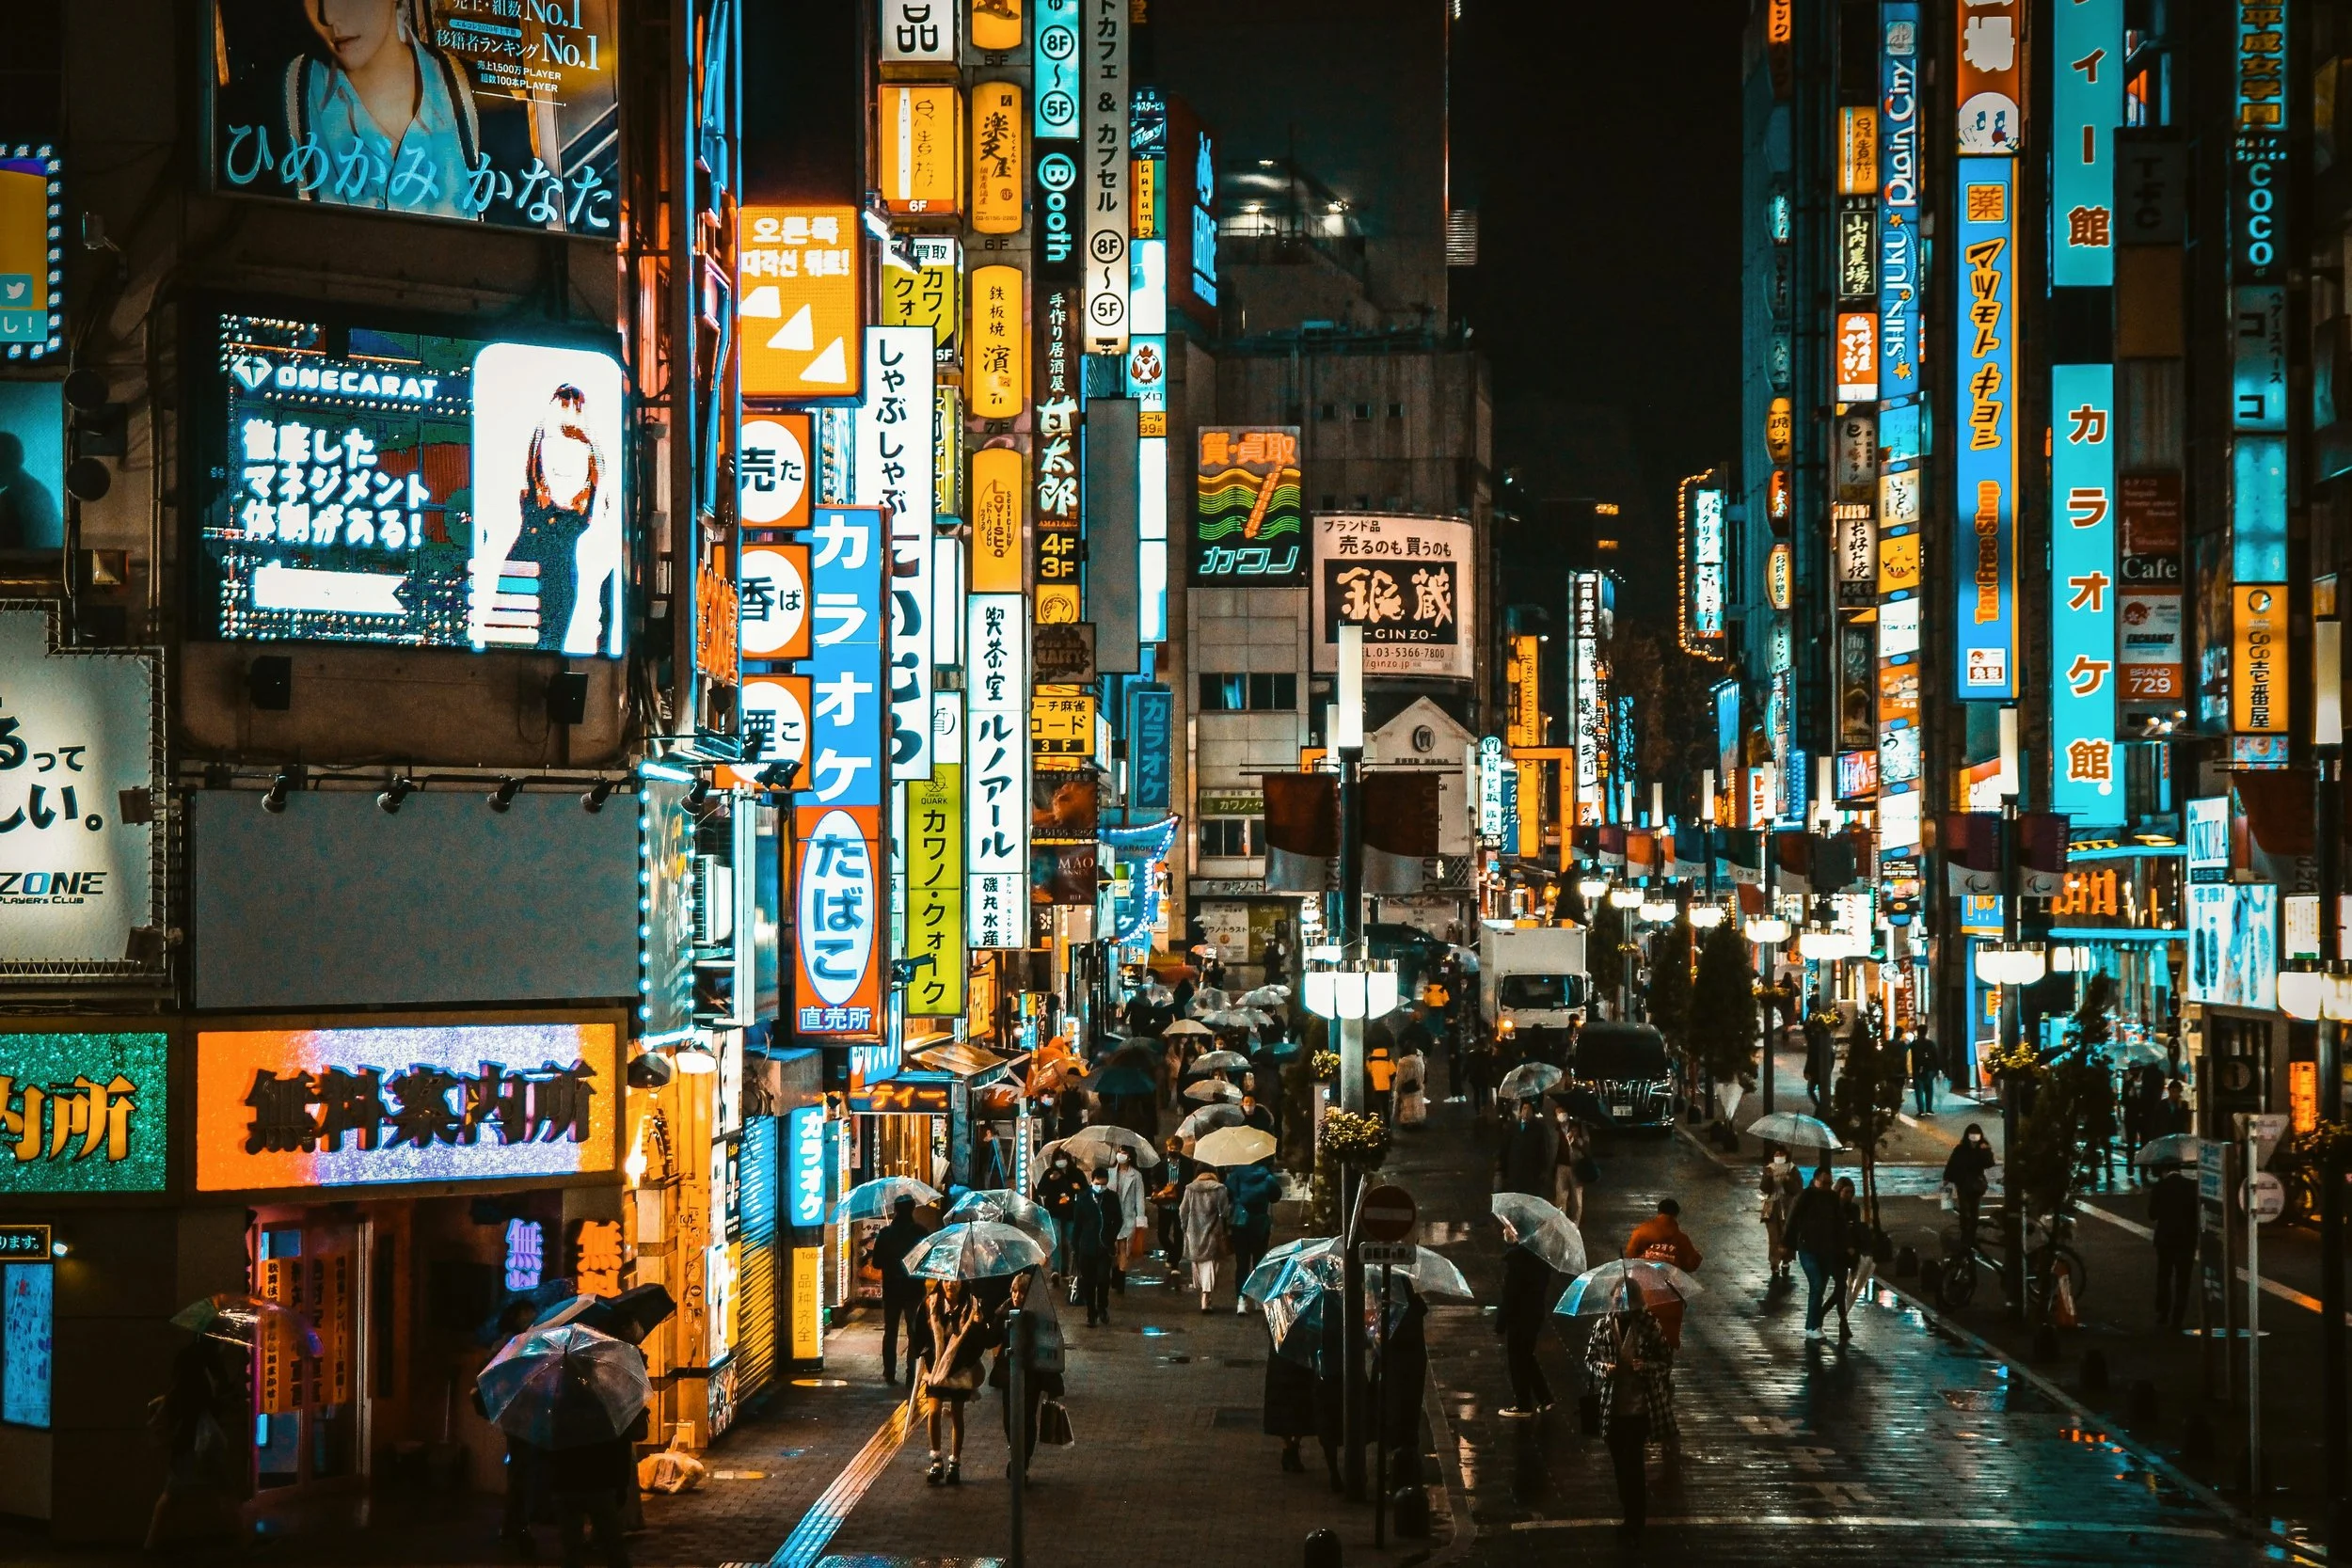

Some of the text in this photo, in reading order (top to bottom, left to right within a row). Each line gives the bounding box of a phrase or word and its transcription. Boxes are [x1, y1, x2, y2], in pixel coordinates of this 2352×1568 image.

[437, 29, 599, 71] 移籍者ランキング No.1
[1046, 35, 1069, 51] 8F
[520, 80, 558, 93] PLAYER
[524, 68, 562, 81] PLAYER
[1046, 101, 1069, 117] 5F
[1098, 92, 1118, 113] &
[2067, 0, 2111, 247] イー館
[227, 123, 612, 229] ひめがみ かなた
[1097, 123, 1119, 213] カプセル
[908, 200, 927, 213] 6F
[2248, 162, 2274, 266] COCO
[1097, 239, 1118, 255] 8F
[988, 286, 1006, 338] 鉄板焼
[1097, 302, 1118, 317] 5F
[1884, 230, 1915, 357] SHINJUKU
[1049, 293, 1067, 392] 手作り居酒屋
[1965, 238, 2006, 451] マツモトキヨシ
[2269, 291, 2284, 384] ヘアースペース
[276, 366, 438, 399] ONECARAT
[875, 339, 908, 518] しゃぶしゃぶ
[244, 465, 429, 509] マネジメント
[1041, 533, 1074, 555] 4F
[1324, 520, 1381, 533] ブランド品
[1041, 556, 1074, 578] 3F
[1198, 546, 1300, 575] カワノ
[1848, 522, 1870, 580] お好み焼
[2122, 557, 2178, 579] Cafe
[2067, 404, 2110, 783] カラオケ館
[811, 515, 873, 802] カラオケ
[2129, 668, 2171, 677] BRAND
[2129, 677, 2172, 694] 729
[978, 606, 1016, 860] 喫茶室 ルノアール
[1139, 697, 1168, 800] カラオケ
[1057, 858, 1094, 869] MAO
[814, 833, 865, 982] たばこ
[922, 810, 947, 1006] カワノ・クォーク
[982, 878, 999, 946] 磯丸水産
[799, 1006, 872, 1032] 直売所
[246, 1059, 597, 1155] 無料案内所
[799, 1110, 825, 1221] カラオケ
